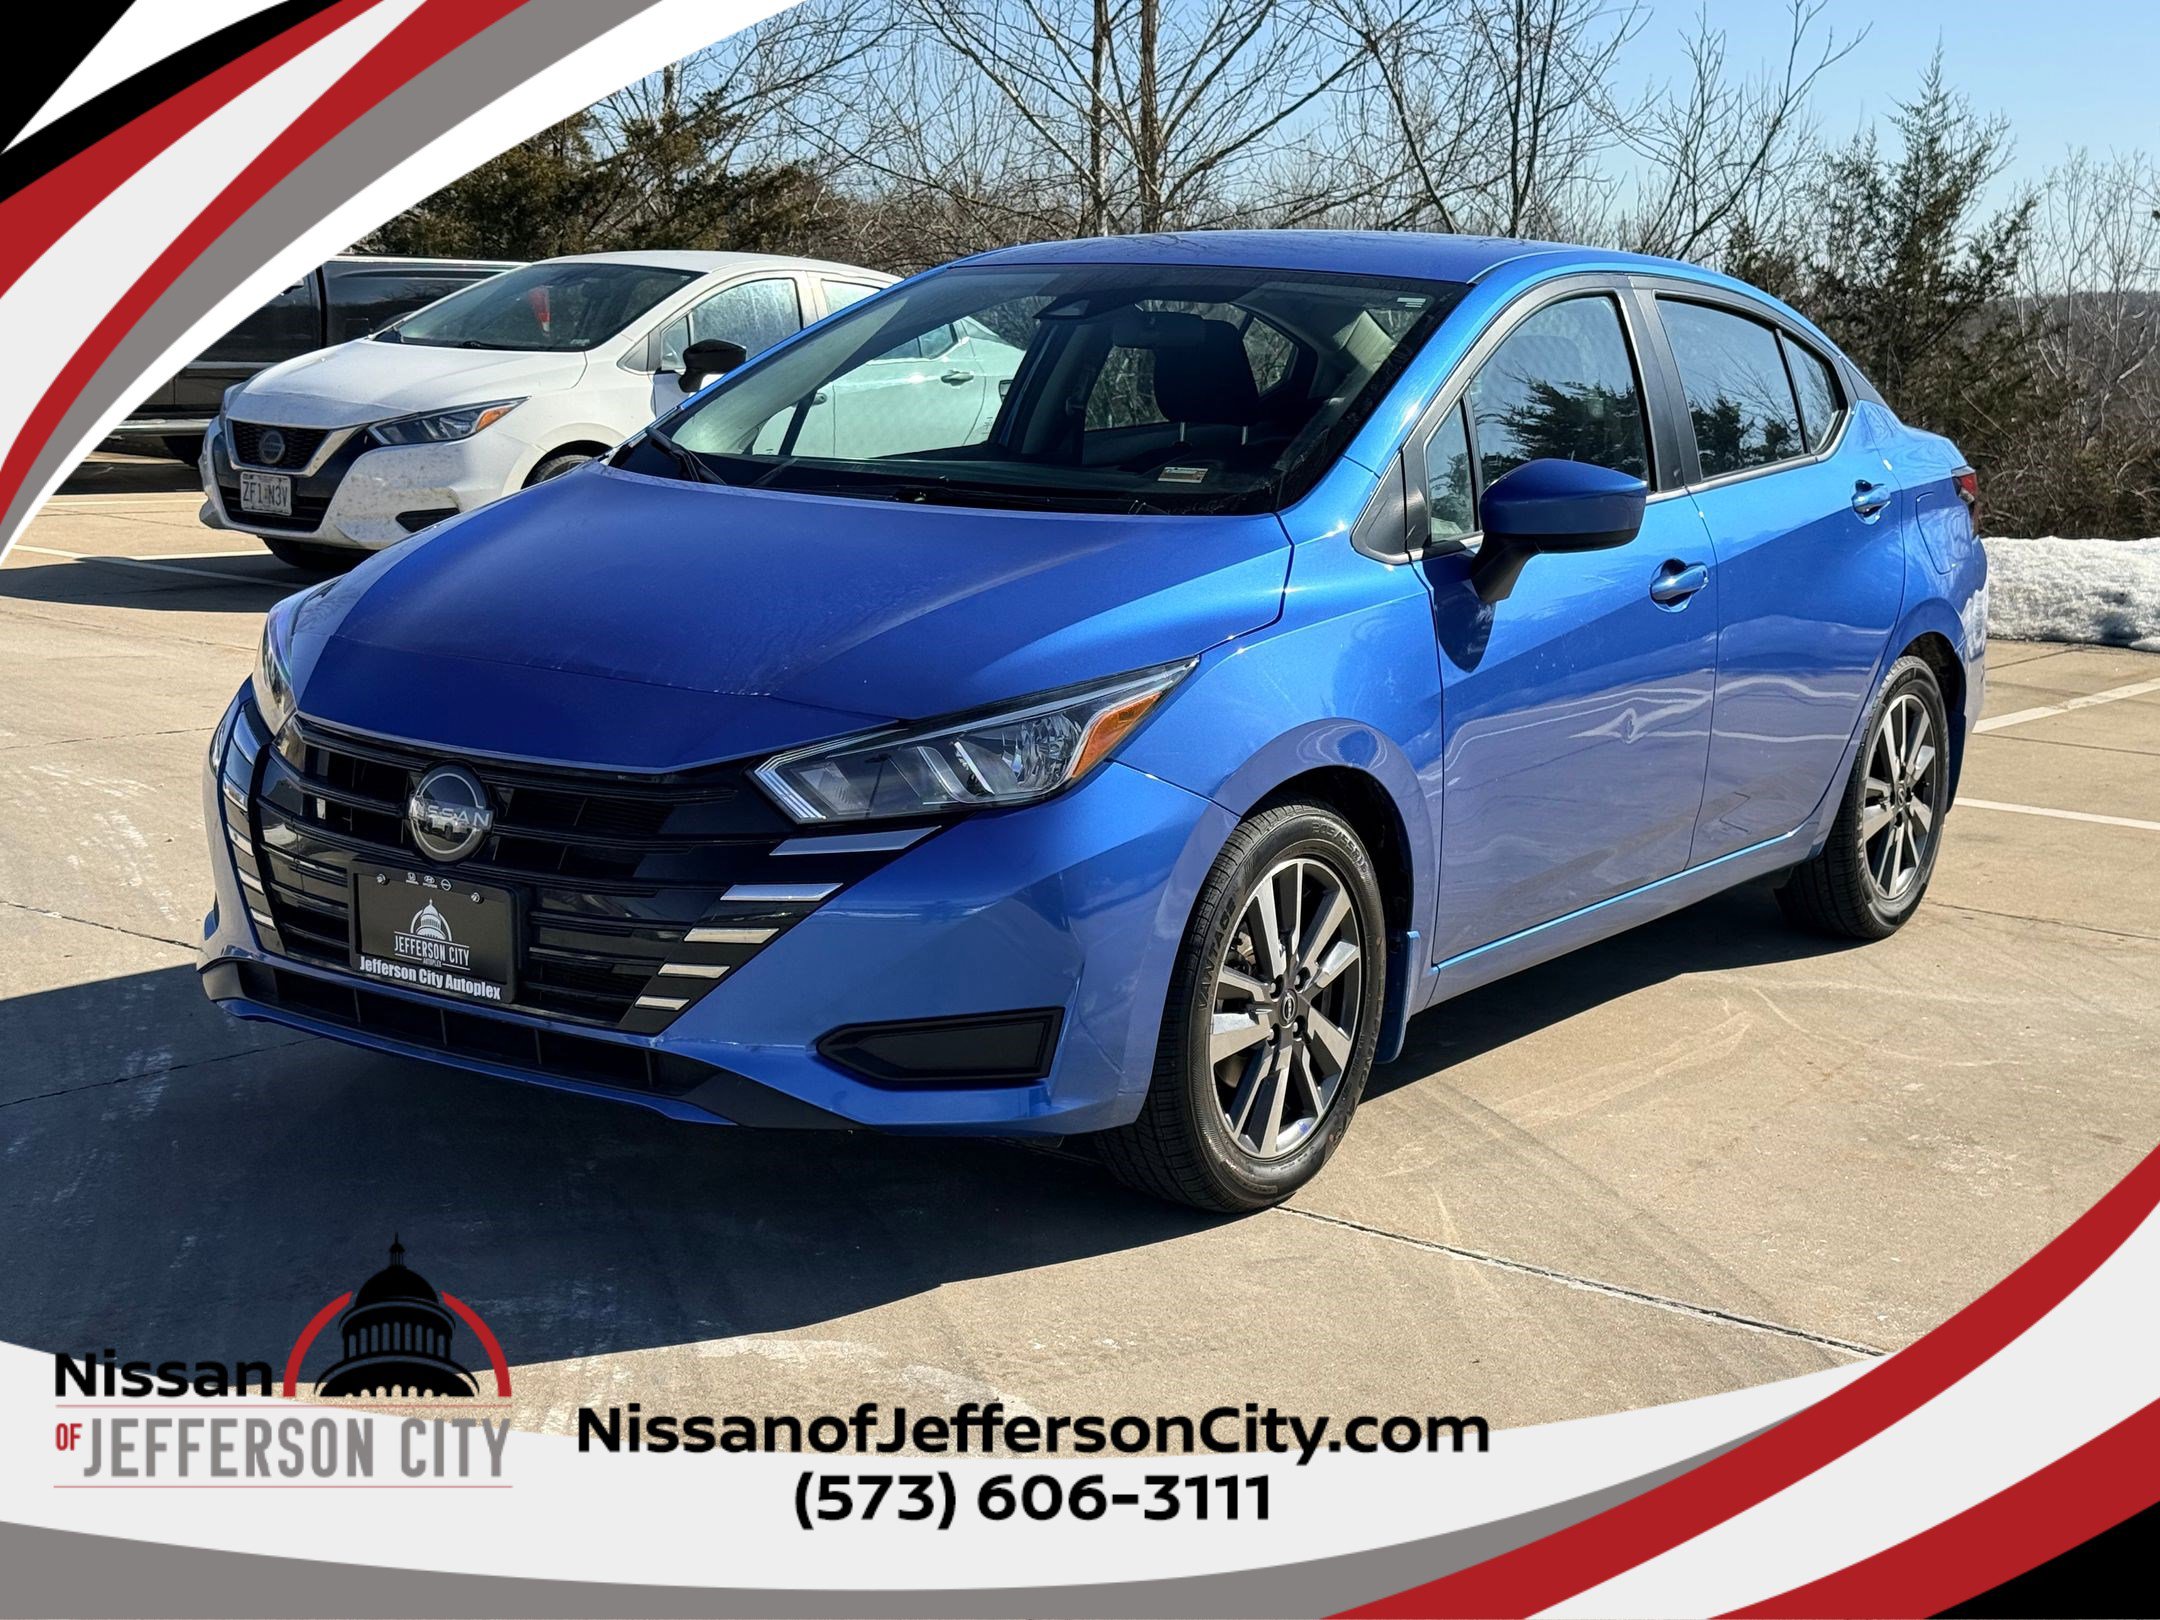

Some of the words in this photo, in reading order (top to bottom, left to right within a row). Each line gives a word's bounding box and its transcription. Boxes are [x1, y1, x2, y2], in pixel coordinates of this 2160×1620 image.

[411, 799, 490, 828] NSSAN
[394, 935, 446, 962] JEFFERSON
[449, 946, 470, 967] CITY
[360, 956, 417, 982] Jefferson
[418, 968, 443, 989] City
[445, 974, 501, 1000] Autoplex
